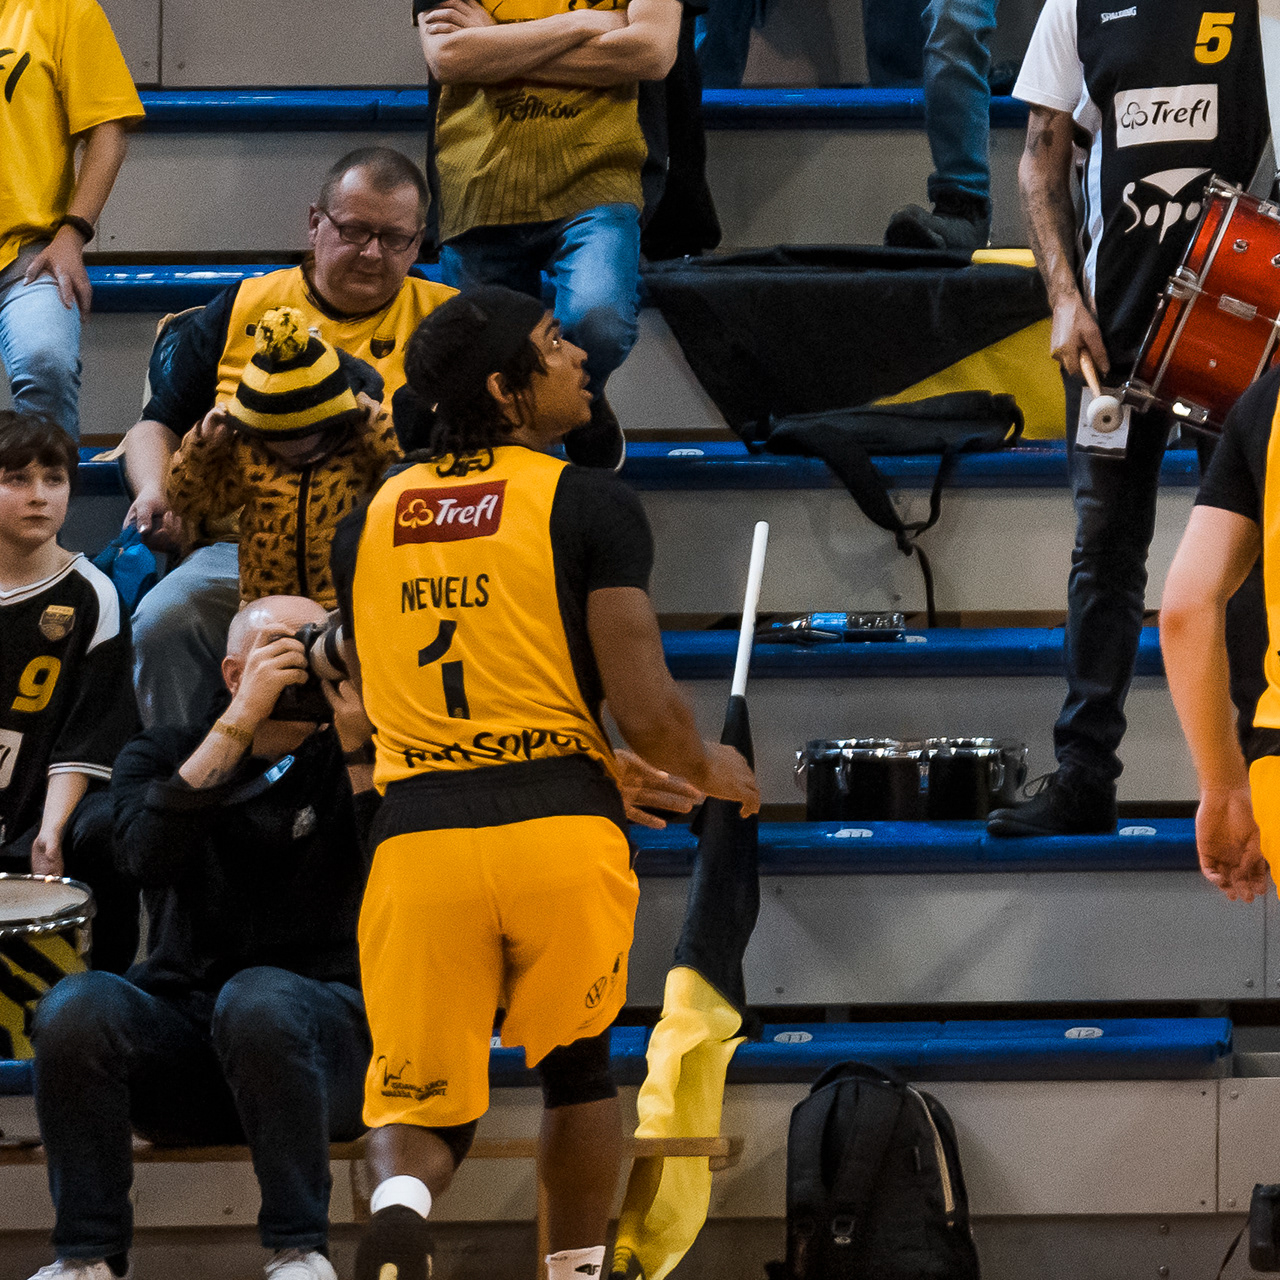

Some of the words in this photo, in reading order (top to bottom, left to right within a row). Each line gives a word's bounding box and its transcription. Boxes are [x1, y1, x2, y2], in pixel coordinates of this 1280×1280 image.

[1194, 12, 1236, 64] 5
[1151, 99, 1212, 128] Trefl
[1122, 181, 1202, 244] Sopo
[434, 494, 499, 527] Trefl
[401, 573, 490, 613] NEVELS
[11, 655, 62, 713] 9
[418, 619, 471, 720] 1
